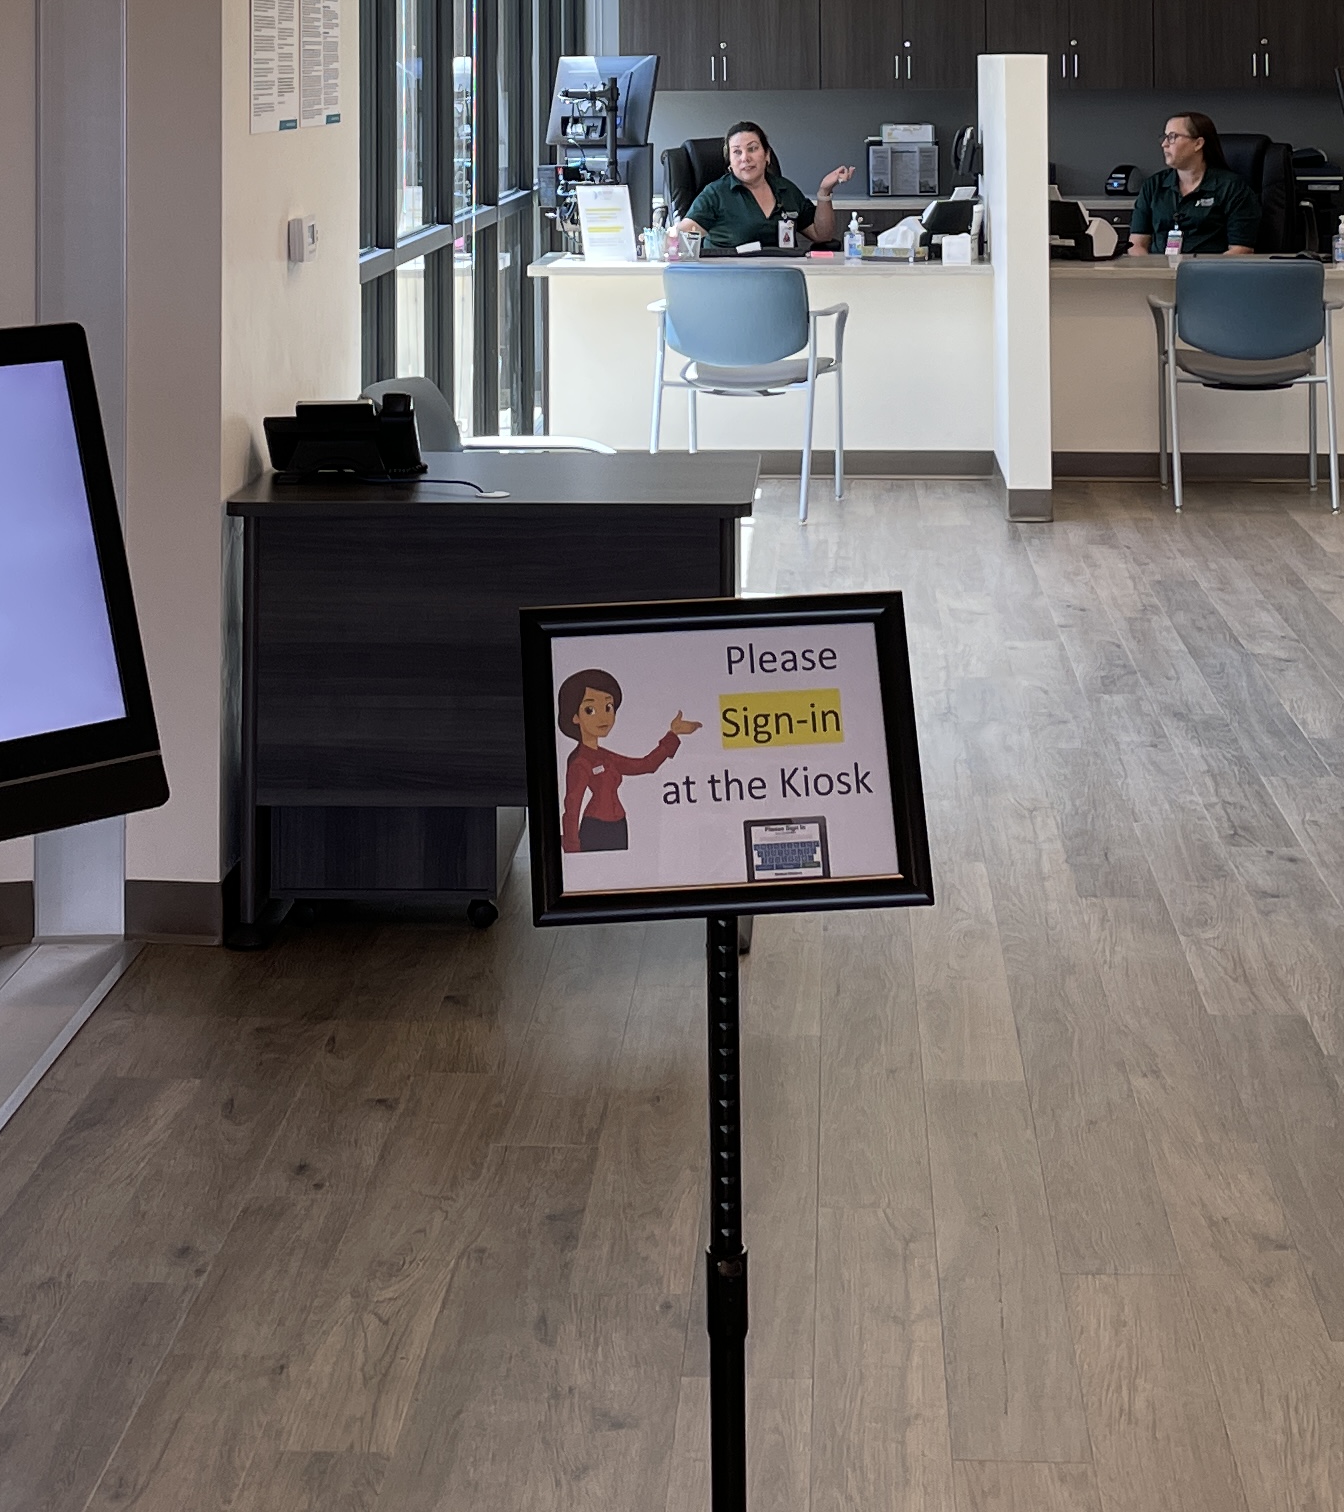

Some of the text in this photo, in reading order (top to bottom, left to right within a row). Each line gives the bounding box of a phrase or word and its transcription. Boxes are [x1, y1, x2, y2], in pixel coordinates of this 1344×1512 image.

[726, 643, 838, 675] Please
[721, 703, 841, 744] Sign-in
[662, 762, 874, 805] at the Kiosk
